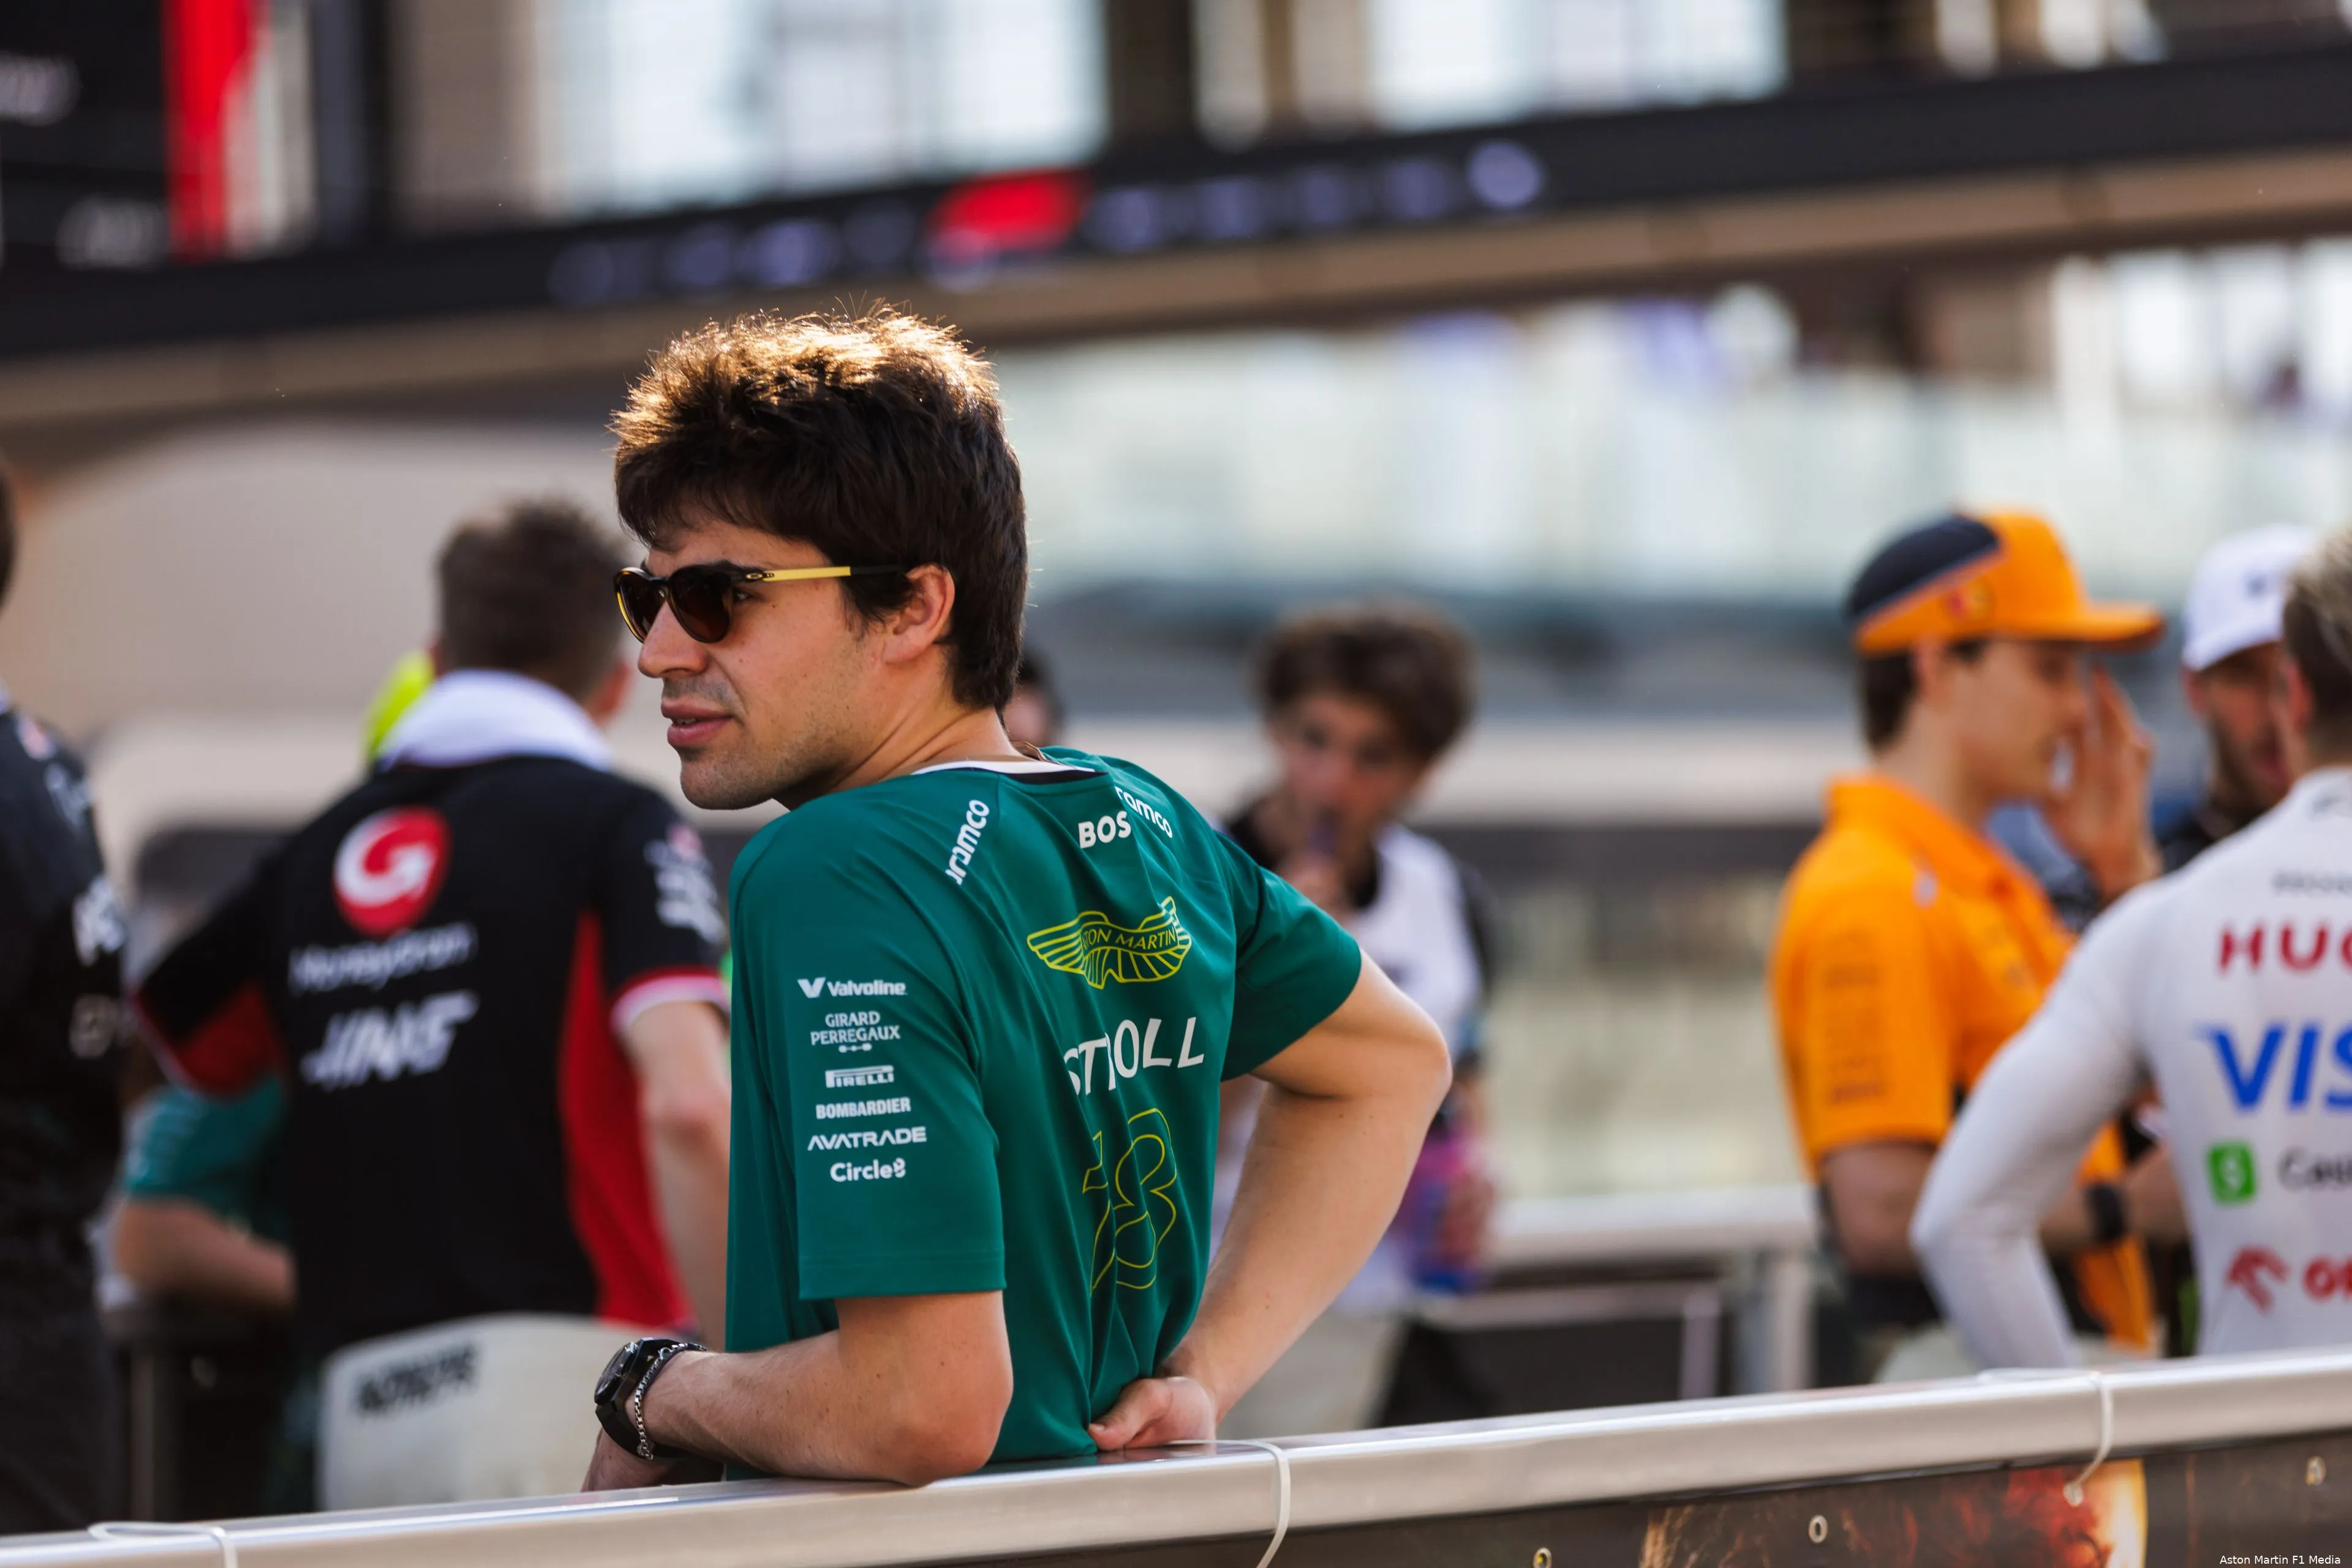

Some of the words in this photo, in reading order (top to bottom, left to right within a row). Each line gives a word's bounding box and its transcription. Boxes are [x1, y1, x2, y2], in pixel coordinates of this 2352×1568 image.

[1115, 926, 1176, 950] MARTIN
[2218, 921, 2352, 975] HU
[827, 980, 906, 997] Valvoline
[825, 1011, 881, 1028] GIRARD
[810, 1025, 901, 1046] PERREGAUX
[825, 1065, 894, 1088] PIRELLI
[815, 1096, 911, 1120] BOMBARDIER
[807, 1126, 927, 1151] AVATRADE
